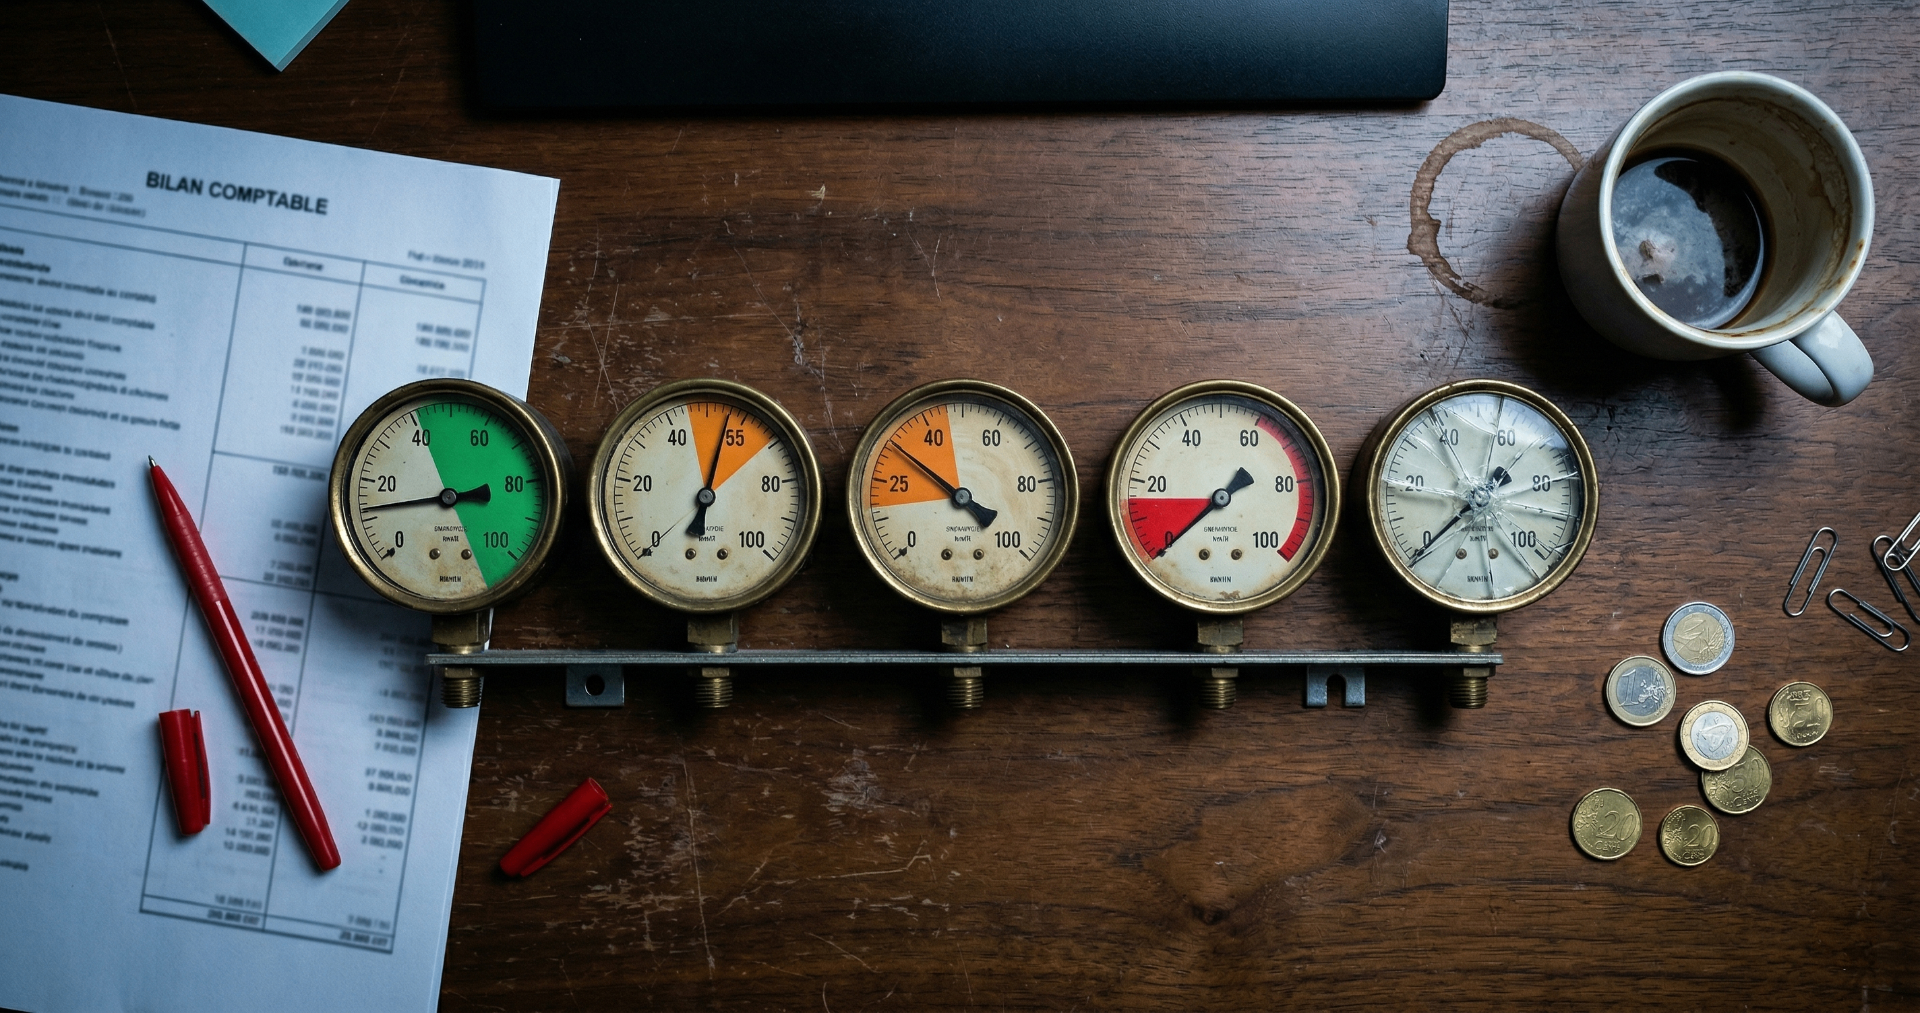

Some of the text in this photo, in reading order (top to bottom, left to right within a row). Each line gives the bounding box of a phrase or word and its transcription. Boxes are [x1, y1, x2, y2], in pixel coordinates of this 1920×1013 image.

[146, 171, 203, 196] BILAN
[208, 181, 329, 215] COMPTABLE
[411, 429, 431, 447] 40
[470, 429, 489, 447] 60
[667, 429, 687, 446] 40
[725, 429, 745, 447] 55
[924, 429, 943, 447] 40
[982, 429, 1001, 447] 60
[1181, 429, 1201, 447] 40
[1239, 429, 1259, 447] 60
[1497, 429, 1516, 447] 60
[377, 475, 396, 492] 20
[504, 475, 524, 493] 80
[633, 475, 652, 492] 20
[761, 475, 780, 493] 80
[889, 475, 909, 492] 25
[1017, 475, 1036, 493] 80
[1147, 475, 1167, 493] 20
[1275, 475, 1294, 493] 80
[1405, 475, 1424, 492] 20
[1532, 475, 1551, 492] 80
[395, 531, 404, 548] 0
[483, 531, 509, 548] 100
[651, 531, 661, 548] 0
[738, 531, 765, 548] 100
[907, 531, 916, 548] 0
[994, 531, 1021, 548] 100
[1164, 531, 1174, 548] 0
[1252, 531, 1279, 548] 100
[1422, 530, 1432, 547] 0
[1510, 531, 1537, 548] 100
[1596, 810, 1637, 841] 20
[1683, 823, 1716, 848] 20
